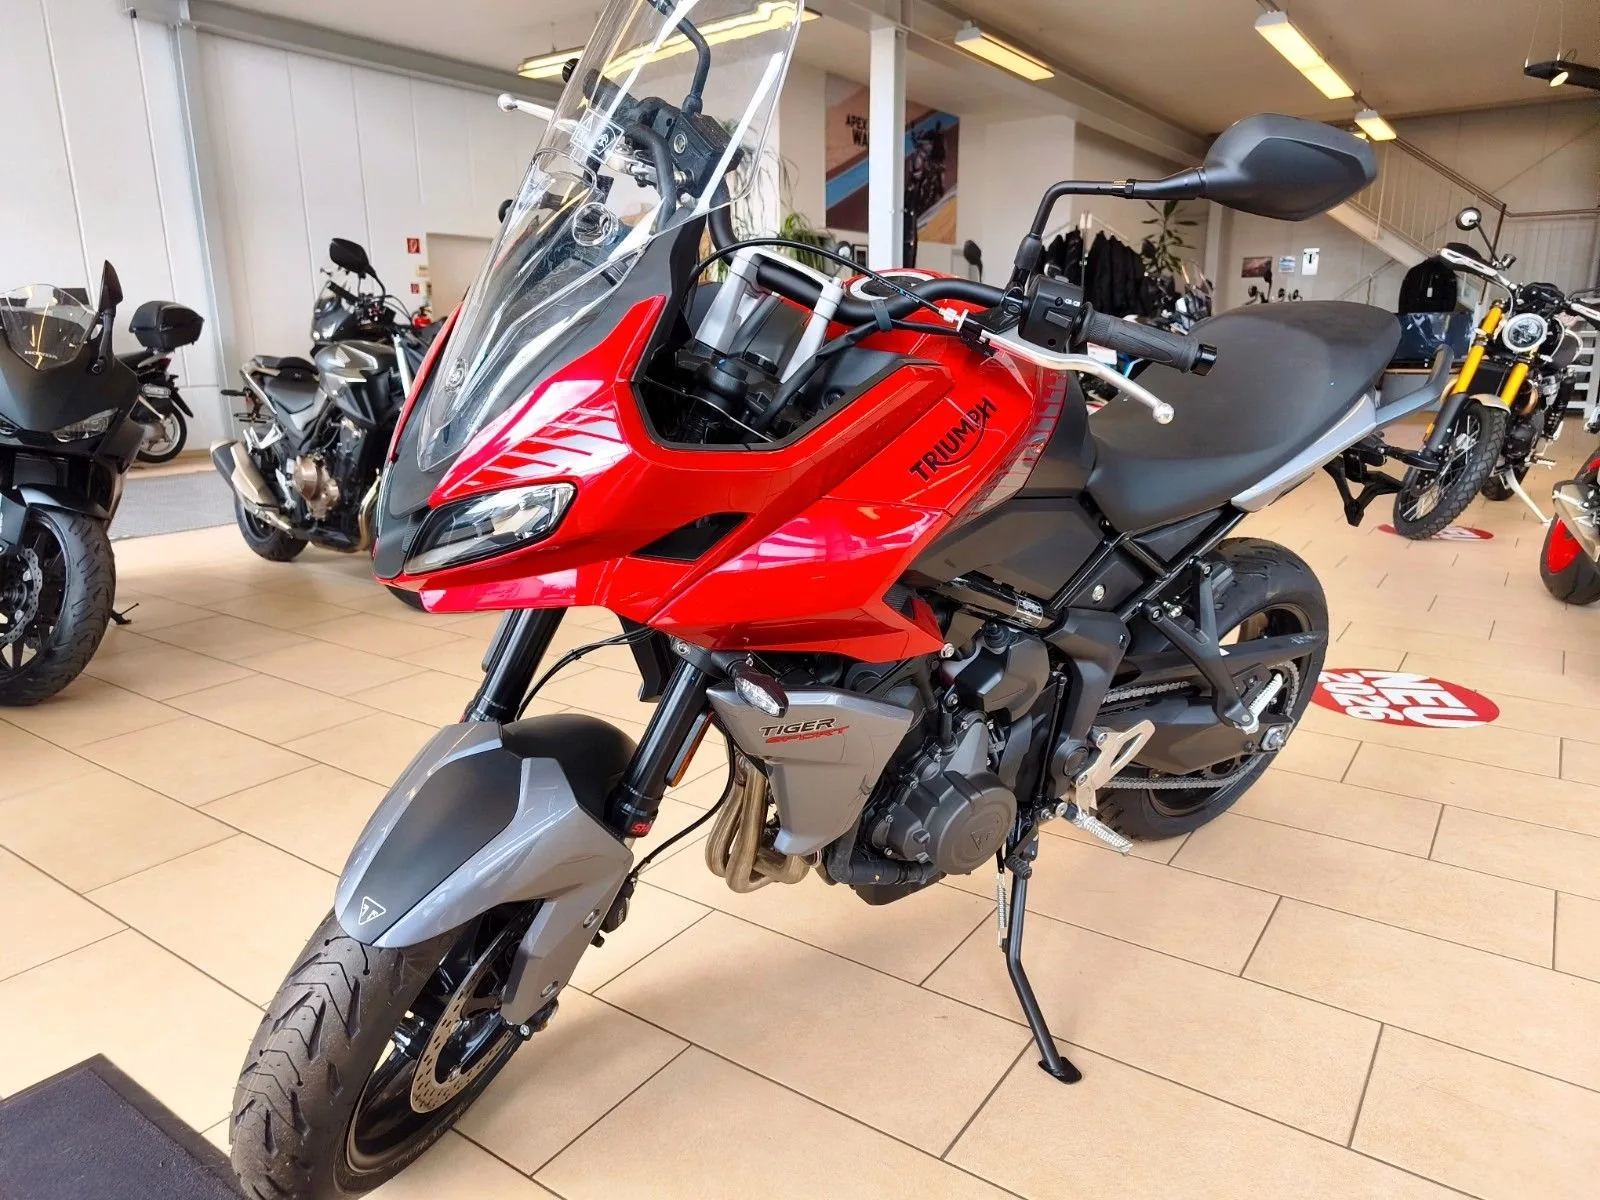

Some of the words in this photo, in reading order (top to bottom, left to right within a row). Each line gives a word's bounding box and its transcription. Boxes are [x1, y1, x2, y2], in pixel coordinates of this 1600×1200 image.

[852, 128, 869, 147] WA
[909, 395, 997, 482] TRIUMPH
[1358, 670, 1489, 729] NEU
[761, 718, 836, 736] TIGER
[766, 725, 850, 744] SPORT
